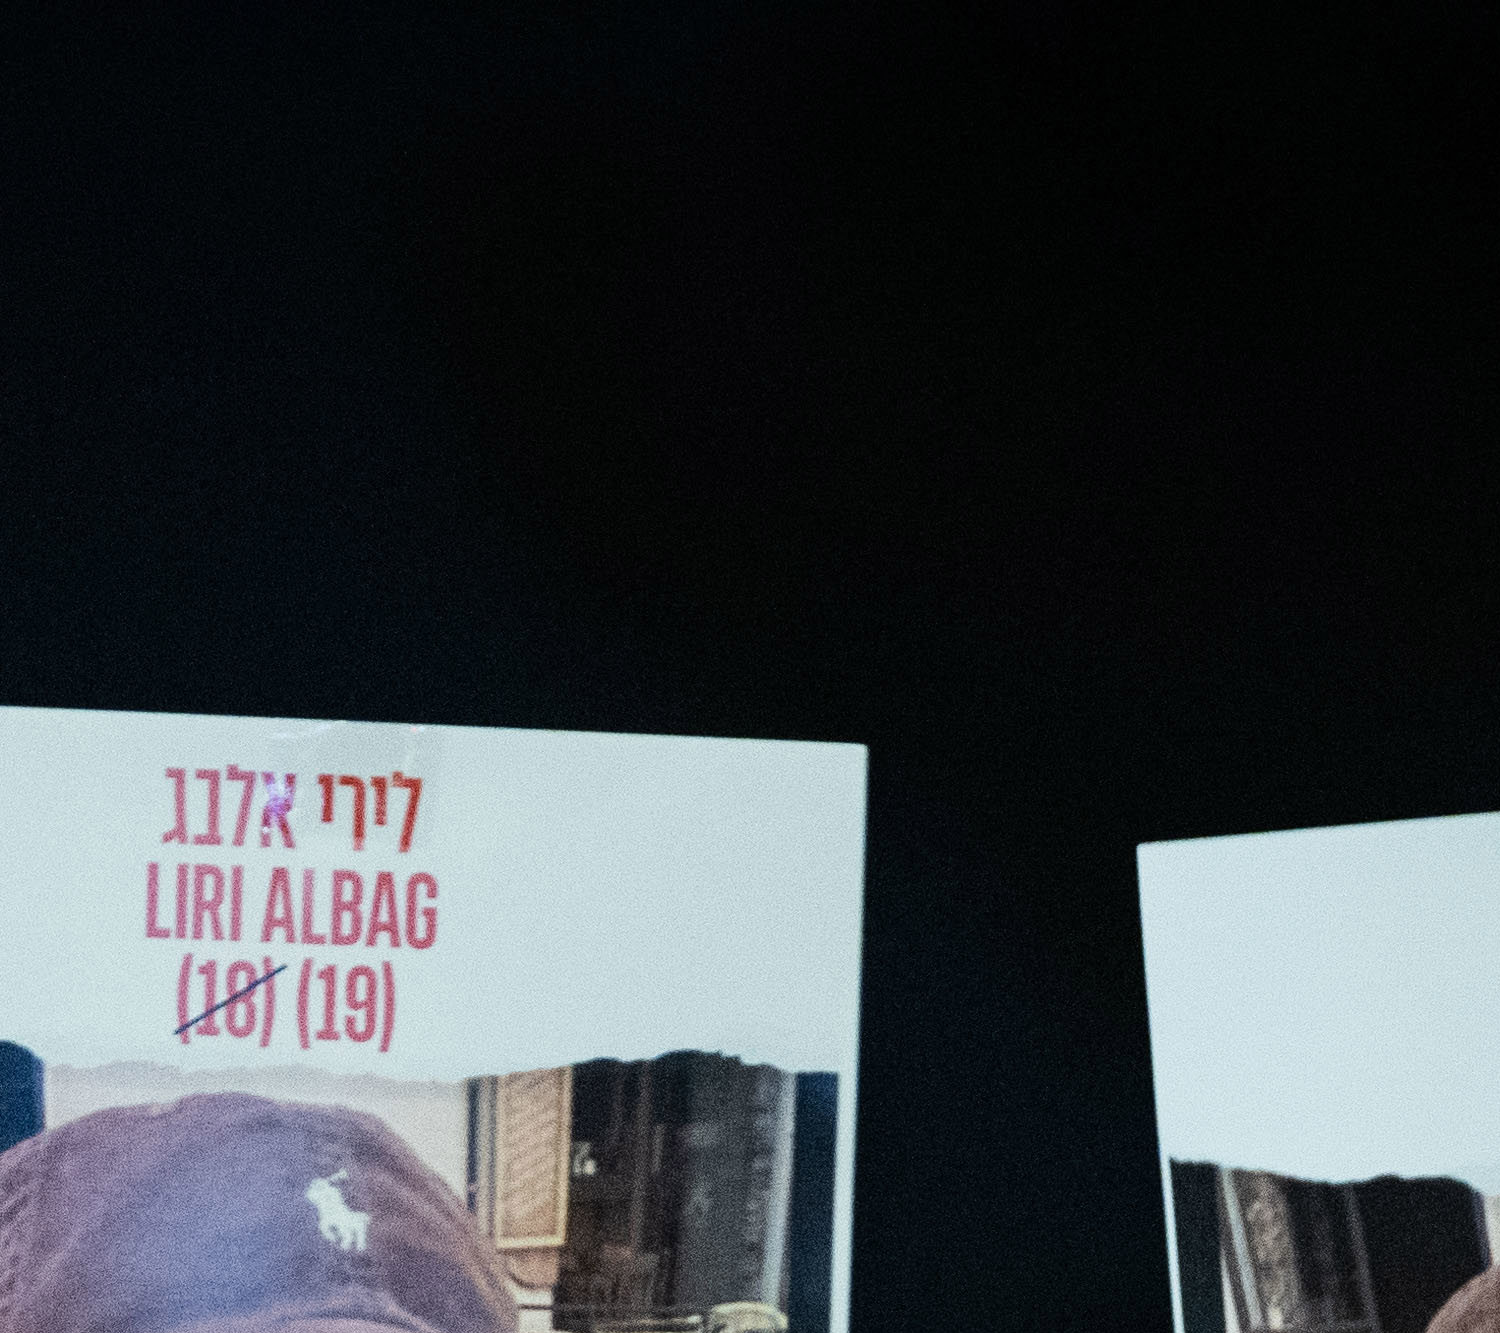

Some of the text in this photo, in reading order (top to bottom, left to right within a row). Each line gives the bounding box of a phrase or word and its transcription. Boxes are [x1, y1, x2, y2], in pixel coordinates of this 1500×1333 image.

[161, 764, 423, 853] לירי אלבג
[145, 861, 439, 950] LIRI ALBAG
[296, 957, 396, 1053] (19)
